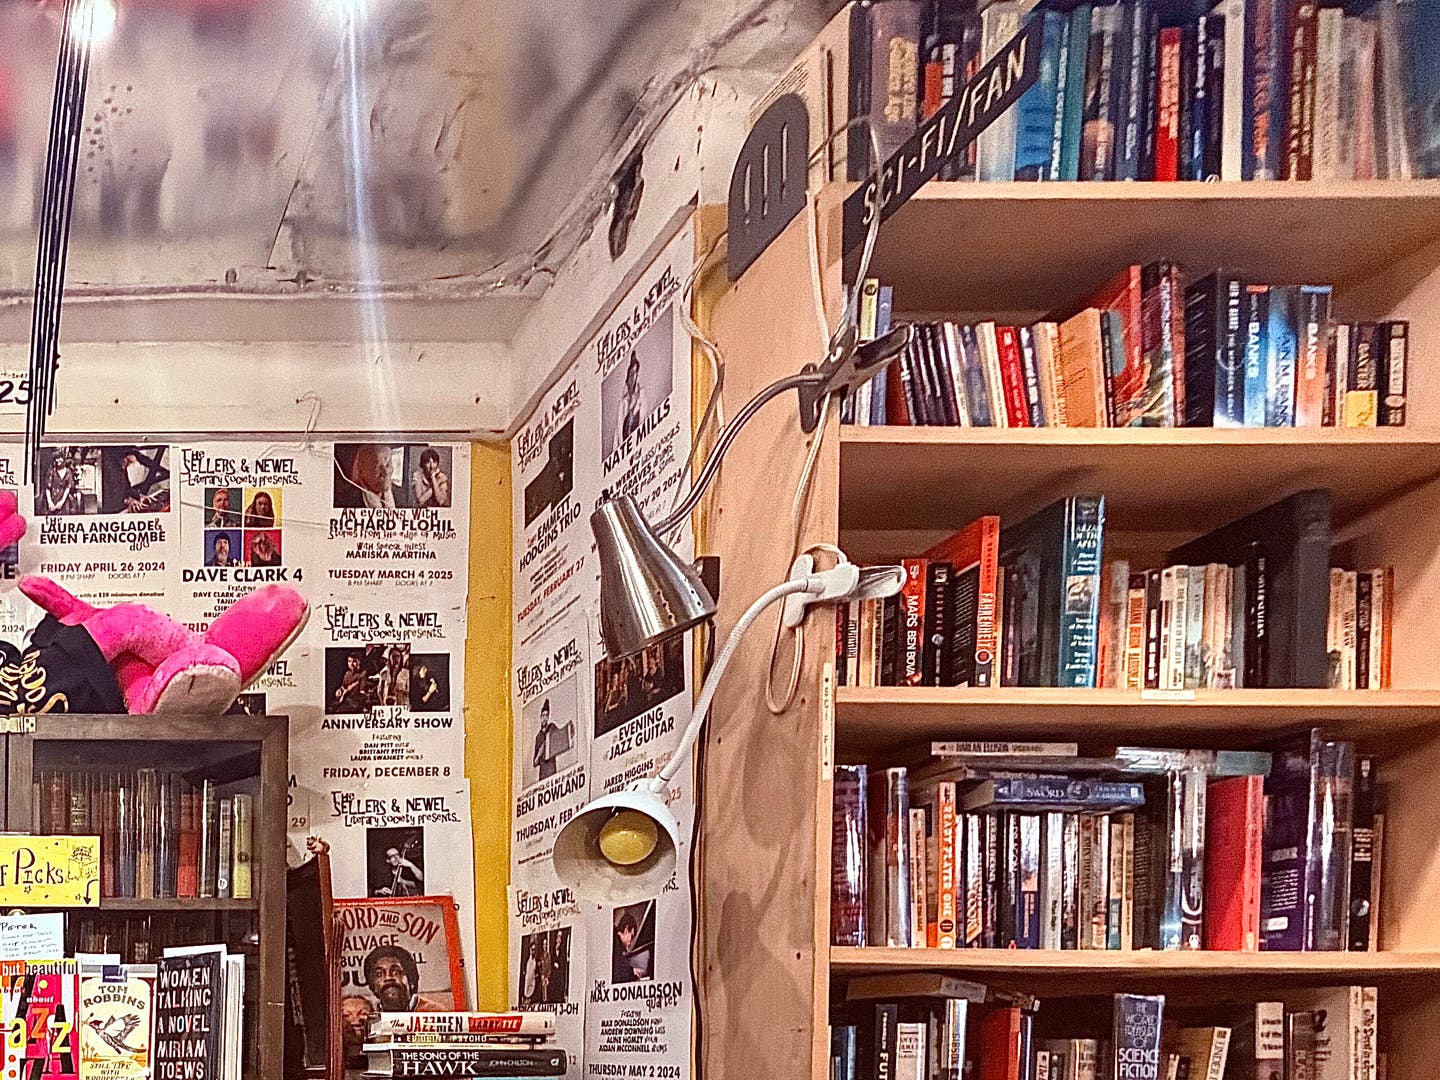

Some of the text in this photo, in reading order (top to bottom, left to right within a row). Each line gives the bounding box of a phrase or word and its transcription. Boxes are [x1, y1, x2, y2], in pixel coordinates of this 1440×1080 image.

[860, 32, 1031, 226] SCI-FI/FAN
[602, 398, 671, 478] NATE MILLS
[182, 459, 299, 475] SELLERS & NEWEL
[537, 495, 571, 541] EMMETT
[560, 502, 581, 530] TRIO
[41, 521, 86, 534] LAURA
[89, 521, 154, 533] ANGLADE
[329, 519, 455, 532] RICHARD FLOHIL
[40, 531, 166, 545] EWEN FARNCOMBE
[346, 550, 437, 559] MARISKA MARTINA
[40, 562, 166, 573] FRIDAY APRIL 26 2024
[182, 568, 303, 583] DAVE CLARK 4
[328, 569, 453, 580] TUESDAY MARCH 4 2025
[324, 612, 442, 630] SELLERS & NEWEL
[978, 592, 993, 650] FAHRENHEIT
[906, 594, 919, 676] MARS BEN BOVA
[321, 717, 453, 730] ANNIVERSARY SHOW
[618, 707, 664, 741] EVENING
[609, 717, 675, 760] JAZZ GUITAR
[323, 767, 451, 779] FRIDAY, DECEMBER 8
[516, 773, 586, 818] BENJ ROWLAND
[332, 797, 449, 817] SELLERS & NEWEL
[380, 912, 440, 944] AND SON
[2, 959, 79, 976] but beautiful
[160, 967, 210, 989] WOMEN
[97, 985, 129, 995] TOM
[158, 988, 211, 1010] TALKING
[590, 981, 683, 1003] MAX DONALDSON
[83, 993, 146, 1011] ROBBINS
[157, 1015, 210, 1034] A NOVEL
[390, 1018, 405, 1028] The
[406, 1016, 464, 1032] JAZZMEN
[500, 1018, 519, 1030] TYE
[158, 1040, 207, 1058] MIRIAM
[401, 1052, 479, 1060] THE SONG OF THE
[160, 1061, 204, 1080] TOEWS
[402, 1061, 479, 1075] HAWK
[589, 1064, 680, 1078] THURSDAY MAY 2 2024
[1119, 1063, 1157, 1079] FICTION
